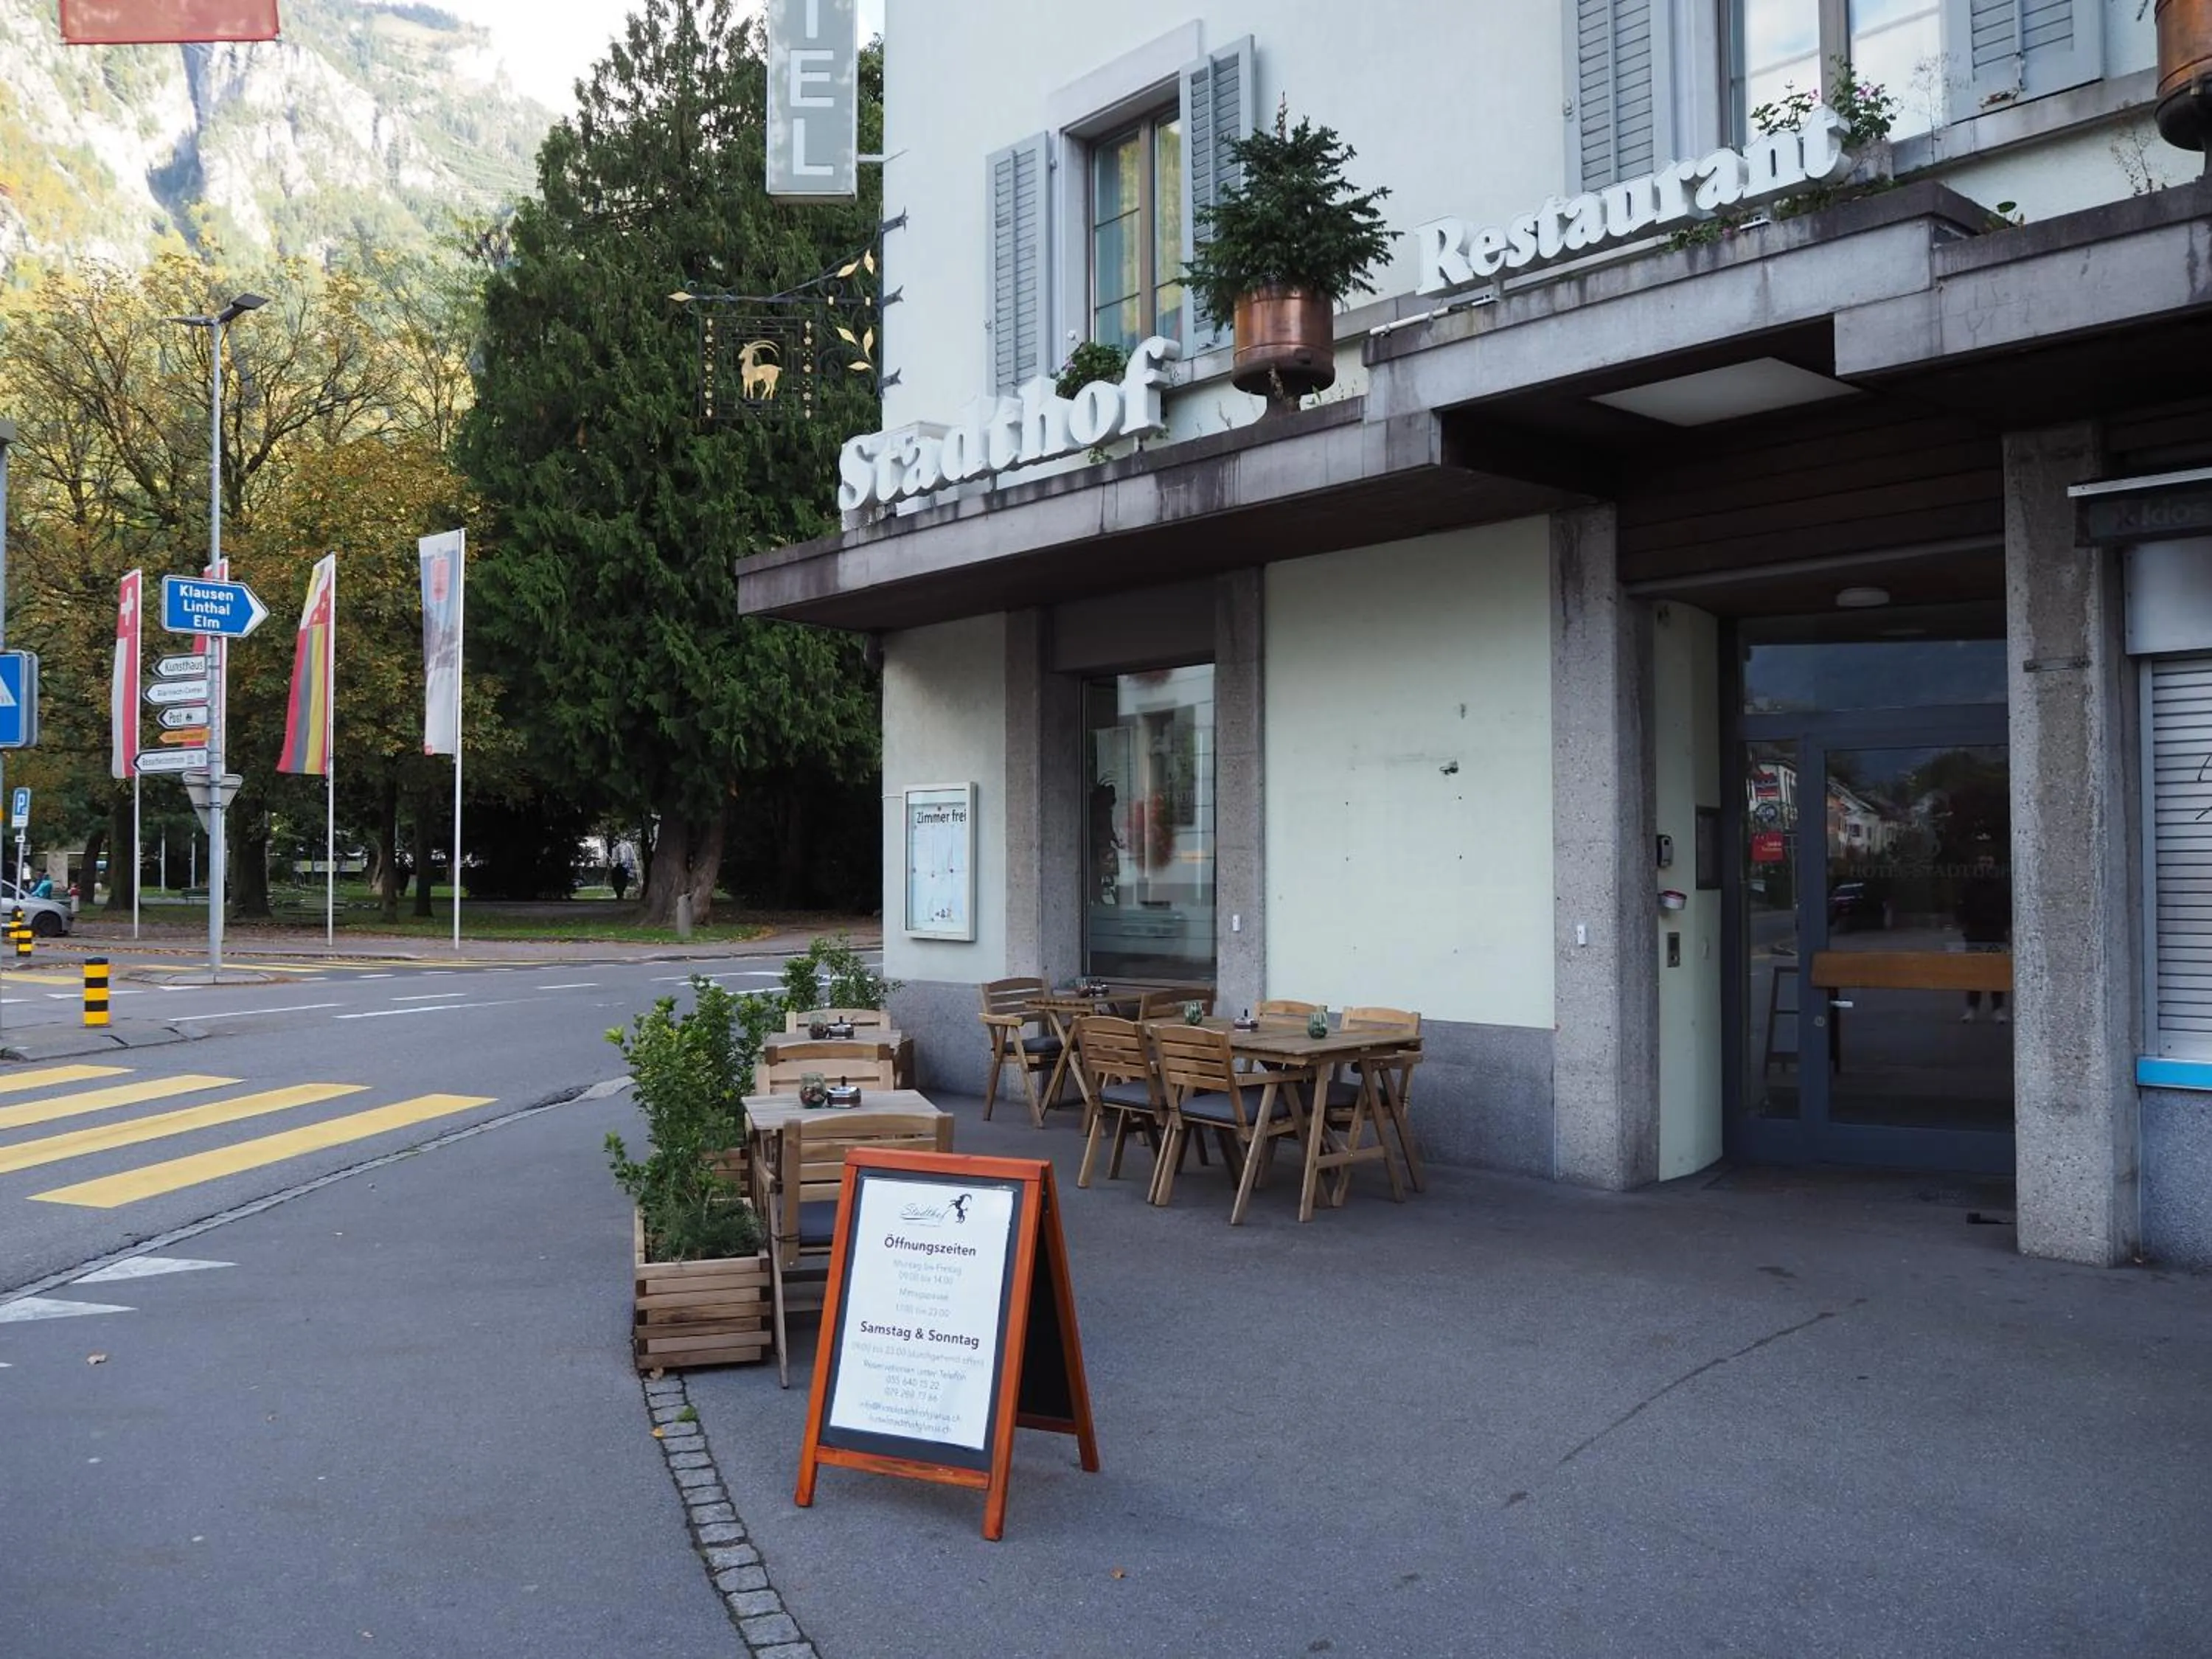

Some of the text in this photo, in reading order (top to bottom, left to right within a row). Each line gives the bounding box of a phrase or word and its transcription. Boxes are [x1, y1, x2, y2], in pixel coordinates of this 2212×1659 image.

[1416, 105, 1851, 296] Restaurant
[839, 335, 1180, 511] Stadthof
[179, 584, 234, 602] Klausen
[184, 599, 230, 616] Linthal
[193, 614, 220, 628] Elm
[164, 660, 203, 672] Kunsthaus
[169, 712, 182, 723] Post
[18, 793, 25, 813] P
[917, 808, 967, 824] Zimmer frei
[884, 1234, 976, 1258] Öffnungszeiten
[860, 1321, 979, 1350] Samstag & Sonntag
